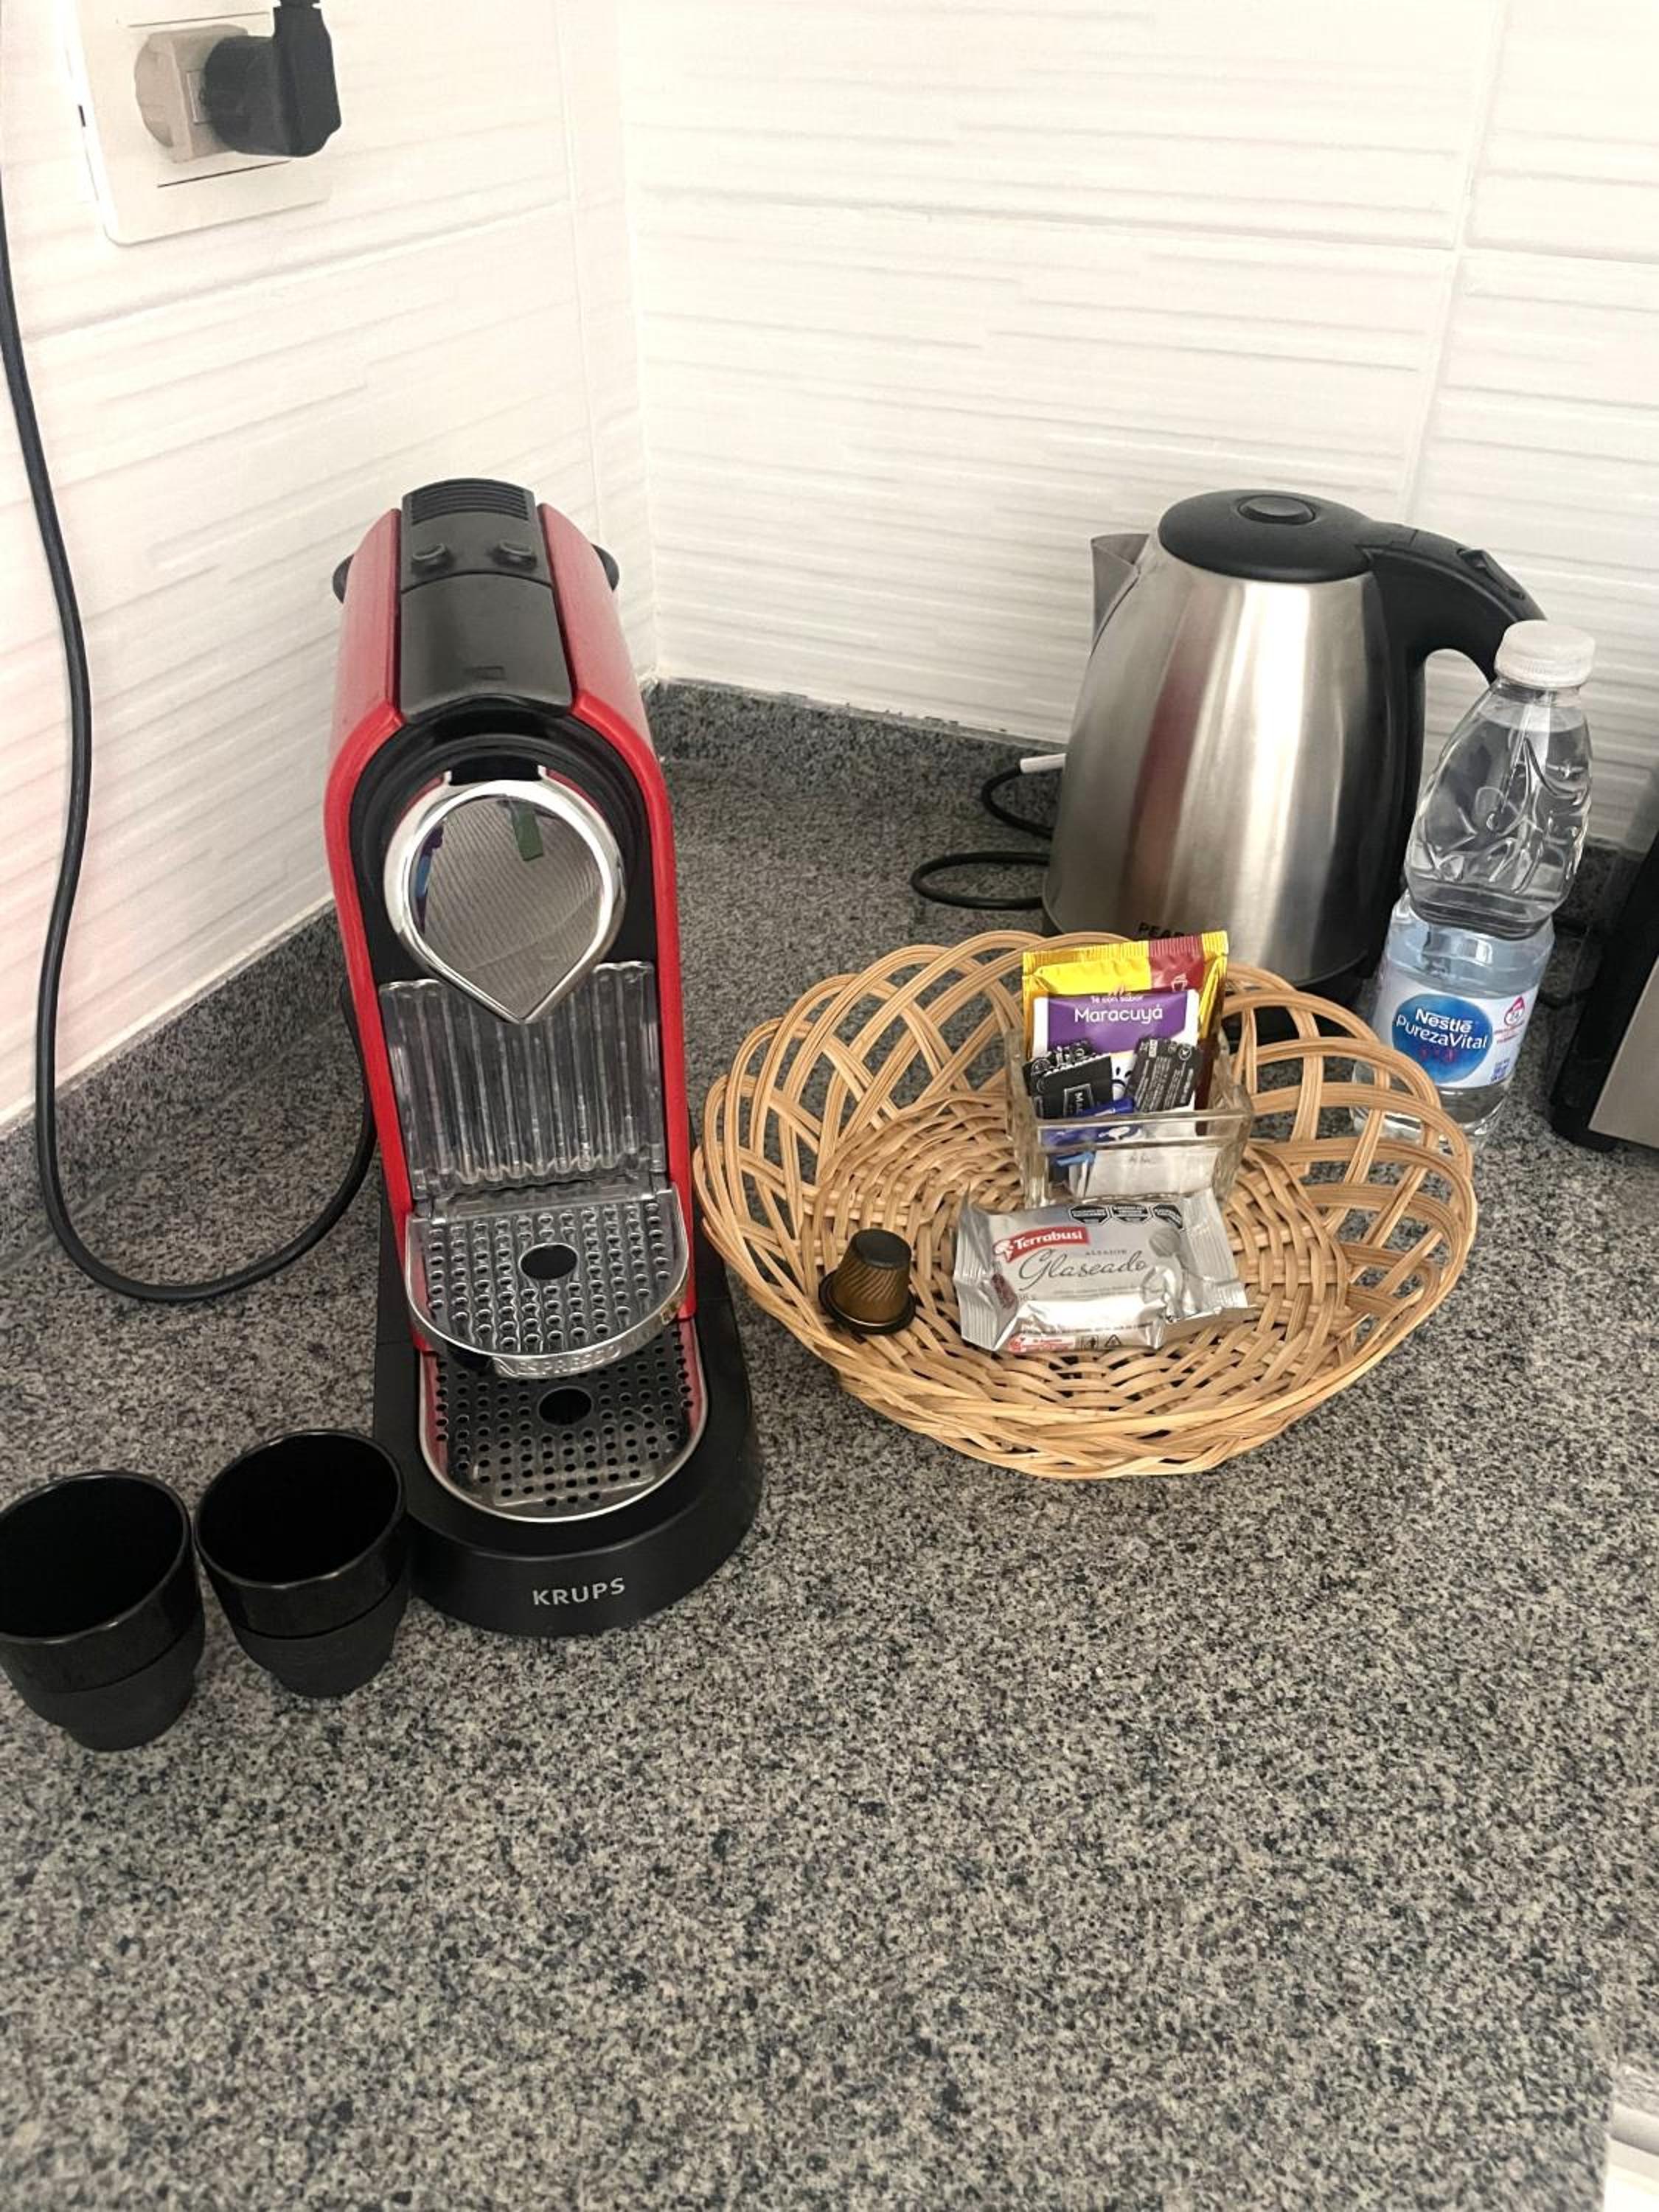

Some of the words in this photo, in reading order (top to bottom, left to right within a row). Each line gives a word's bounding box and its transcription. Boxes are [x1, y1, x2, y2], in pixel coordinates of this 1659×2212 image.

[1074, 1004, 1164, 1024] Maracuyá
[1395, 1014, 1489, 1050] PurezaVital
[1013, 1230, 1083, 1250] Terrabusi
[1018, 1248, 1147, 1291] Glaseado
[532, 1577, 626, 1606] KRUPS
